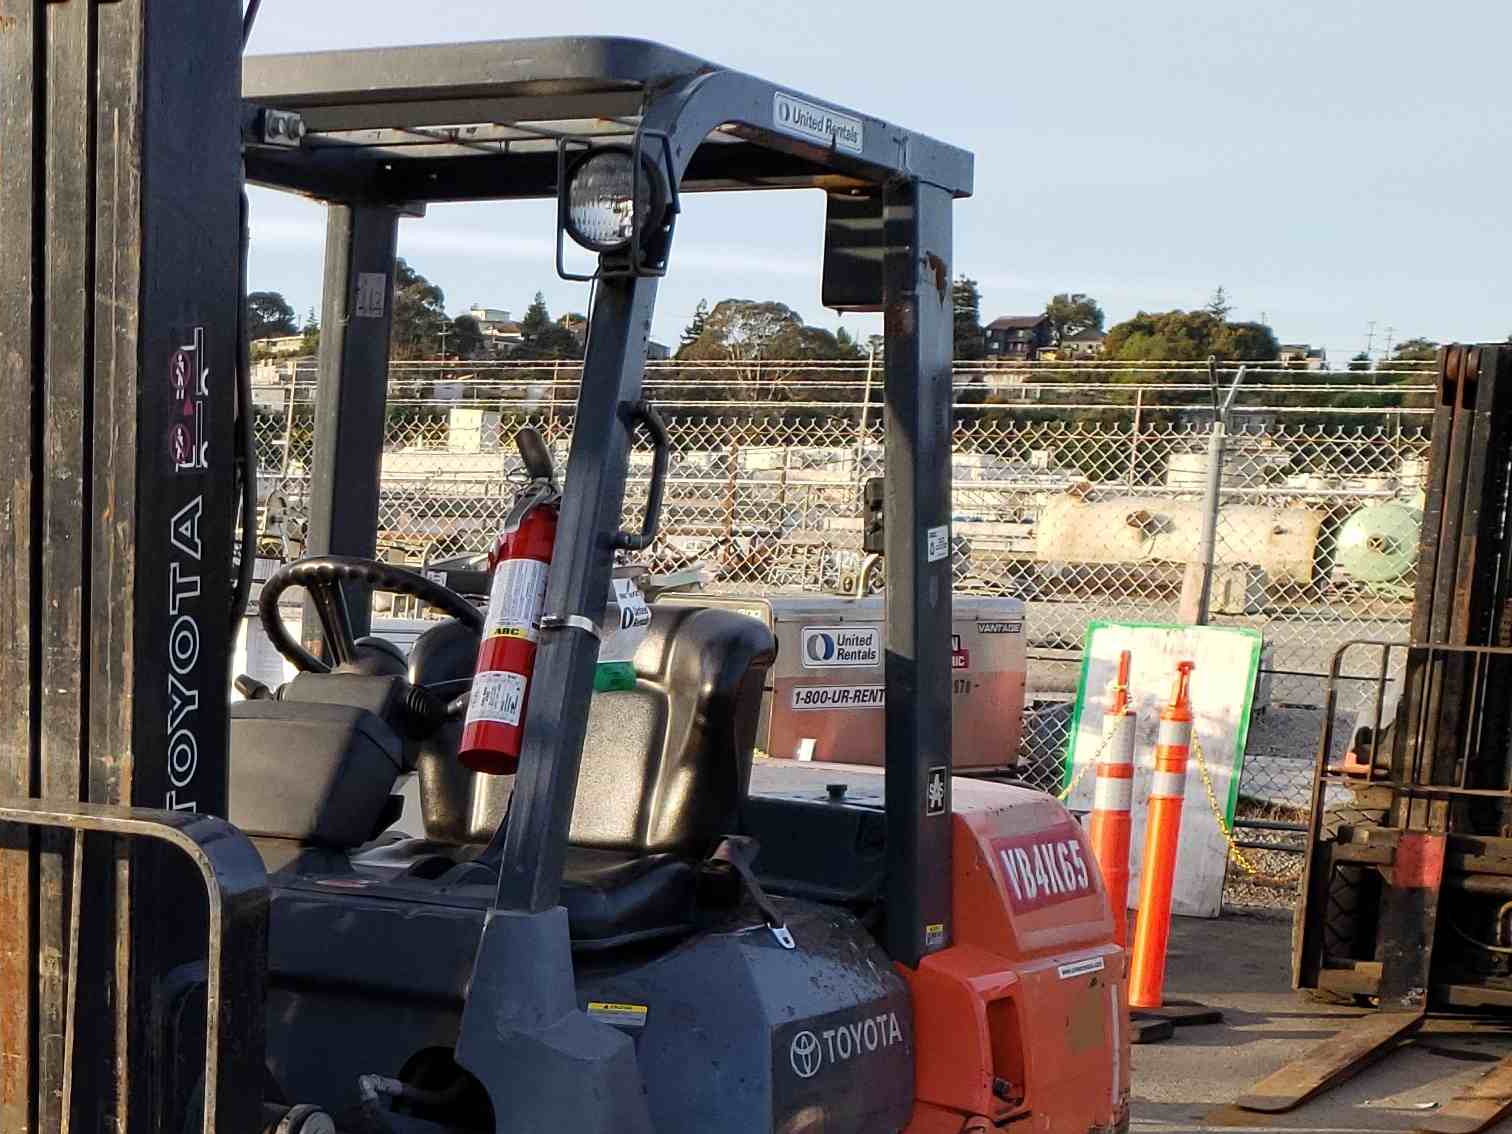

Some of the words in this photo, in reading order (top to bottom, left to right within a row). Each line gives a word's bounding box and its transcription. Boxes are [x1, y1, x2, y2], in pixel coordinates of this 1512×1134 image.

[792, 105, 824, 132] United
[825, 118, 858, 144] Rentals
[494, 627, 520, 636] ABC
[837, 634, 873, 647] United
[978, 623, 1021, 633] VANTAGE
[166, 495, 202, 814] TOYOTA
[837, 649, 877, 661] Rentals
[999, 840, 1089, 901] YB4K65
[823, 1012, 903, 1063] TOYOTA
